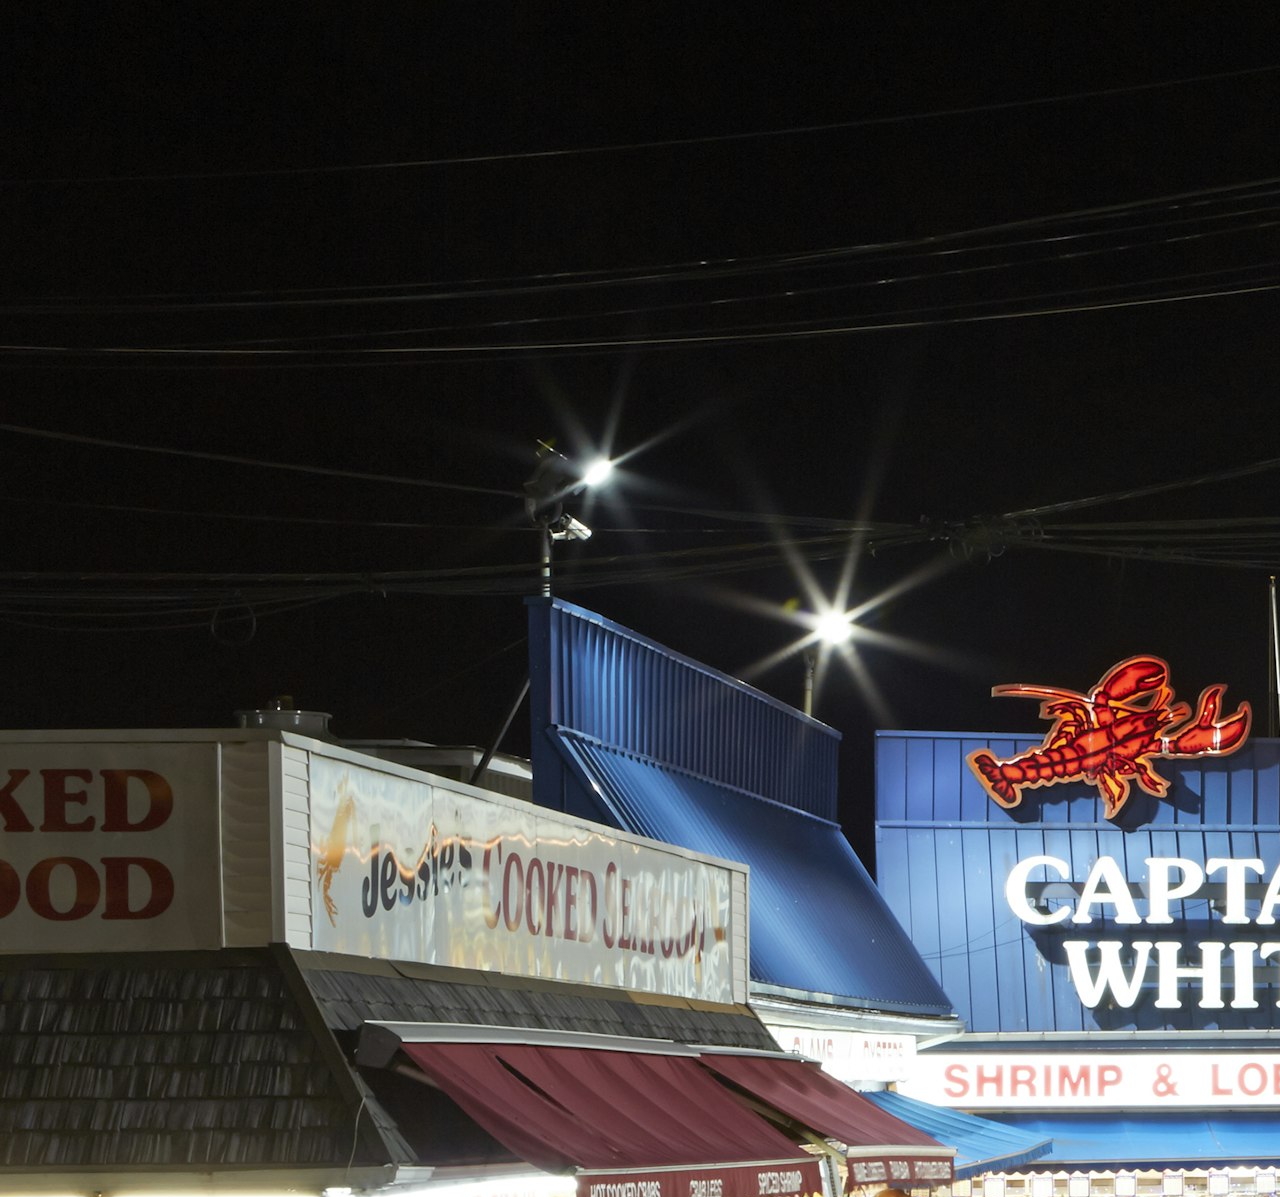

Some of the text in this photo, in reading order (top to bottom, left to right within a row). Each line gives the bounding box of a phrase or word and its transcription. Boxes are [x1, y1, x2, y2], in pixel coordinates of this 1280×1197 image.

[482, 839, 599, 945] COOKED
[943, 1063, 1123, 1099] SHRIMP
[1151, 1065, 1180, 1098] &
